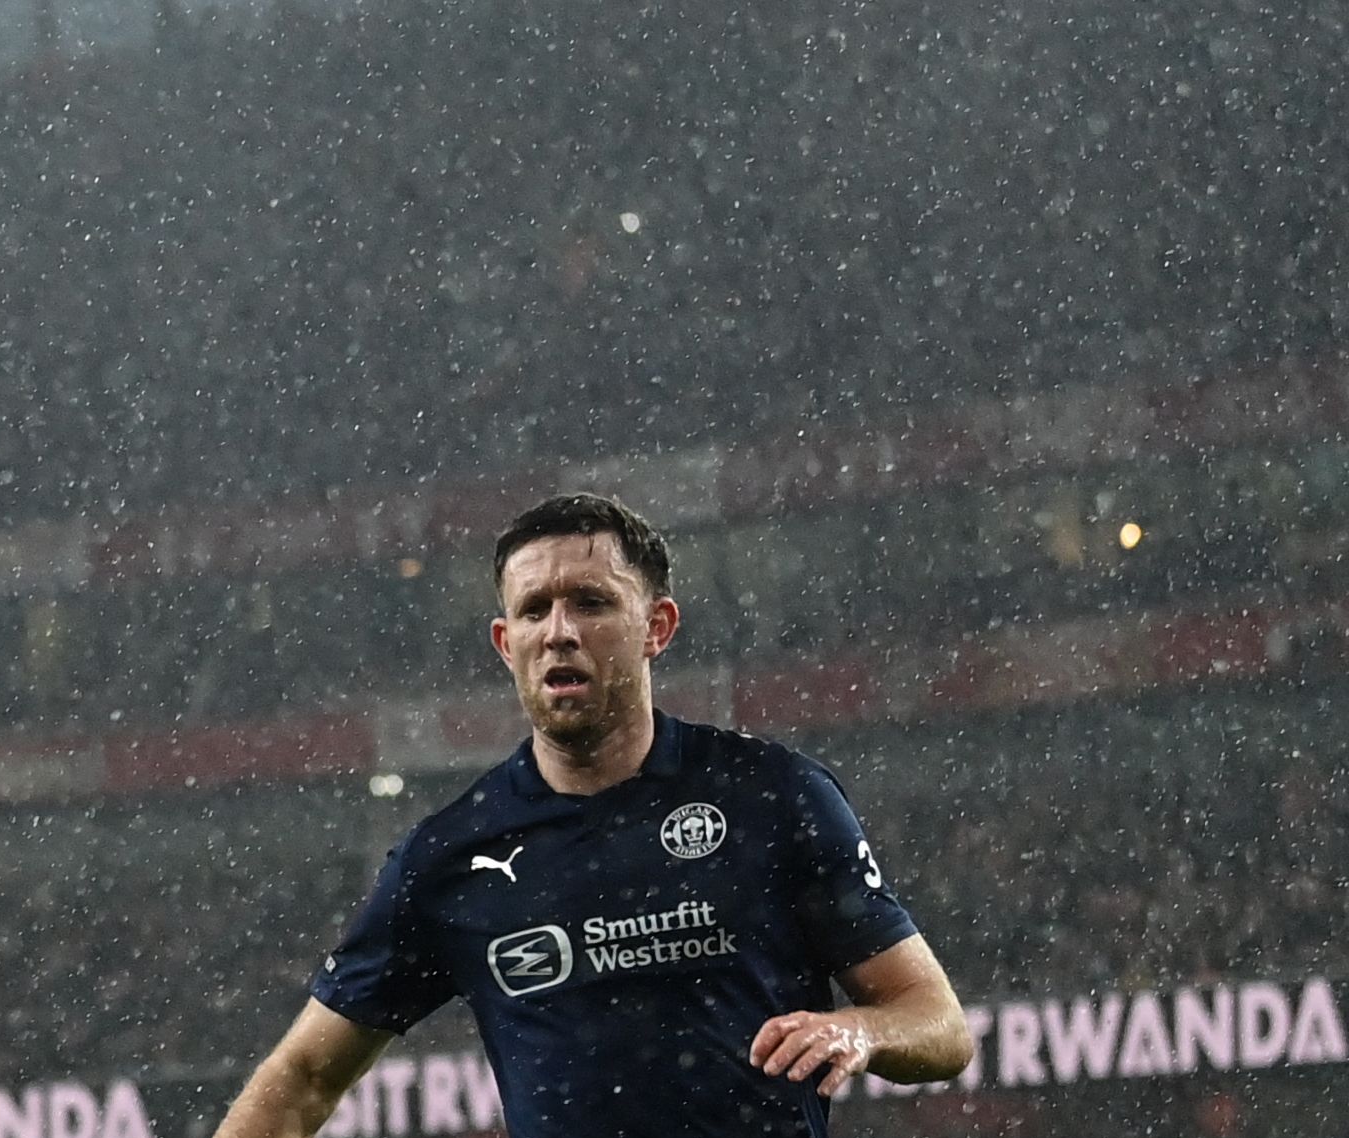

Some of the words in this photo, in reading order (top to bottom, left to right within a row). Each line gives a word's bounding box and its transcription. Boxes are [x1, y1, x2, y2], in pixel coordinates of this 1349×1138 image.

[857, 839, 883, 889] 3
[583, 901, 717, 945] Smurfit
[585, 928, 739, 974] Westrock
